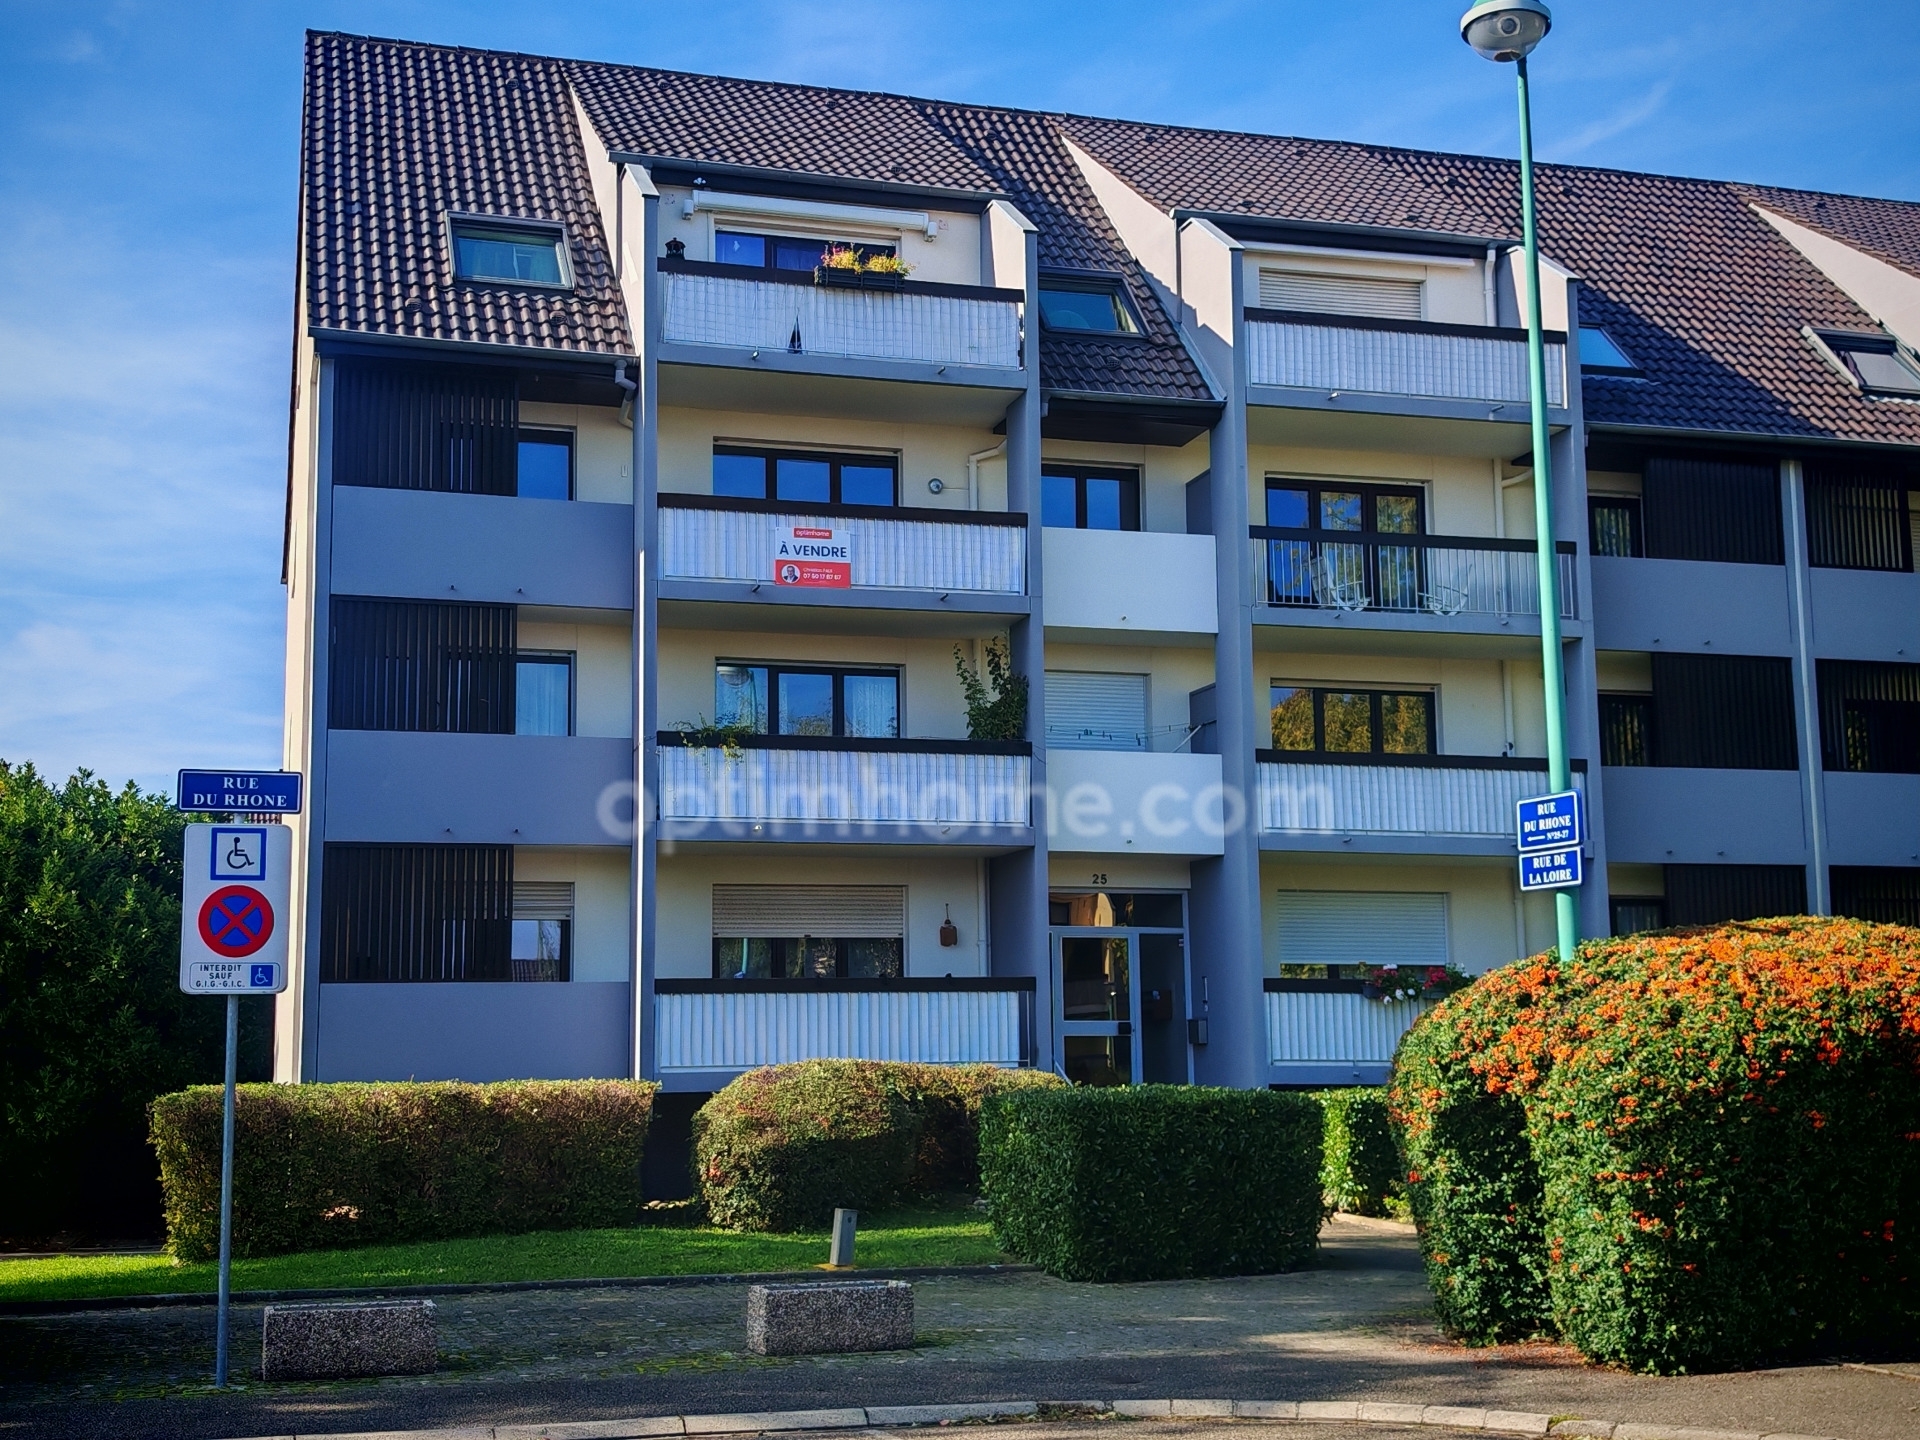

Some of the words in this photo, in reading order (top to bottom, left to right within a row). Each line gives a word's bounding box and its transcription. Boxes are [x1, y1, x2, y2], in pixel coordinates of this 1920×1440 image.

[779, 541, 789, 555] À
[793, 545, 847, 557] VENDRE
[223, 777, 259, 789] RUE
[193, 793, 217, 805] DU
[224, 794, 287, 807] RHONE
[1537, 802, 1556, 815] RUE
[1524, 820, 1537, 833] DU
[1539, 815, 1571, 830] RHONE
[1533, 856, 1552, 869] RUE
[1554, 853, 1567, 866] DE
[1092, 873, 1107, 885] 25
[1529, 873, 1542, 884] LA
[1543, 868, 1572, 883] LOIRE
[196, 980, 245, 988] G.I.G.-G.I.C.
